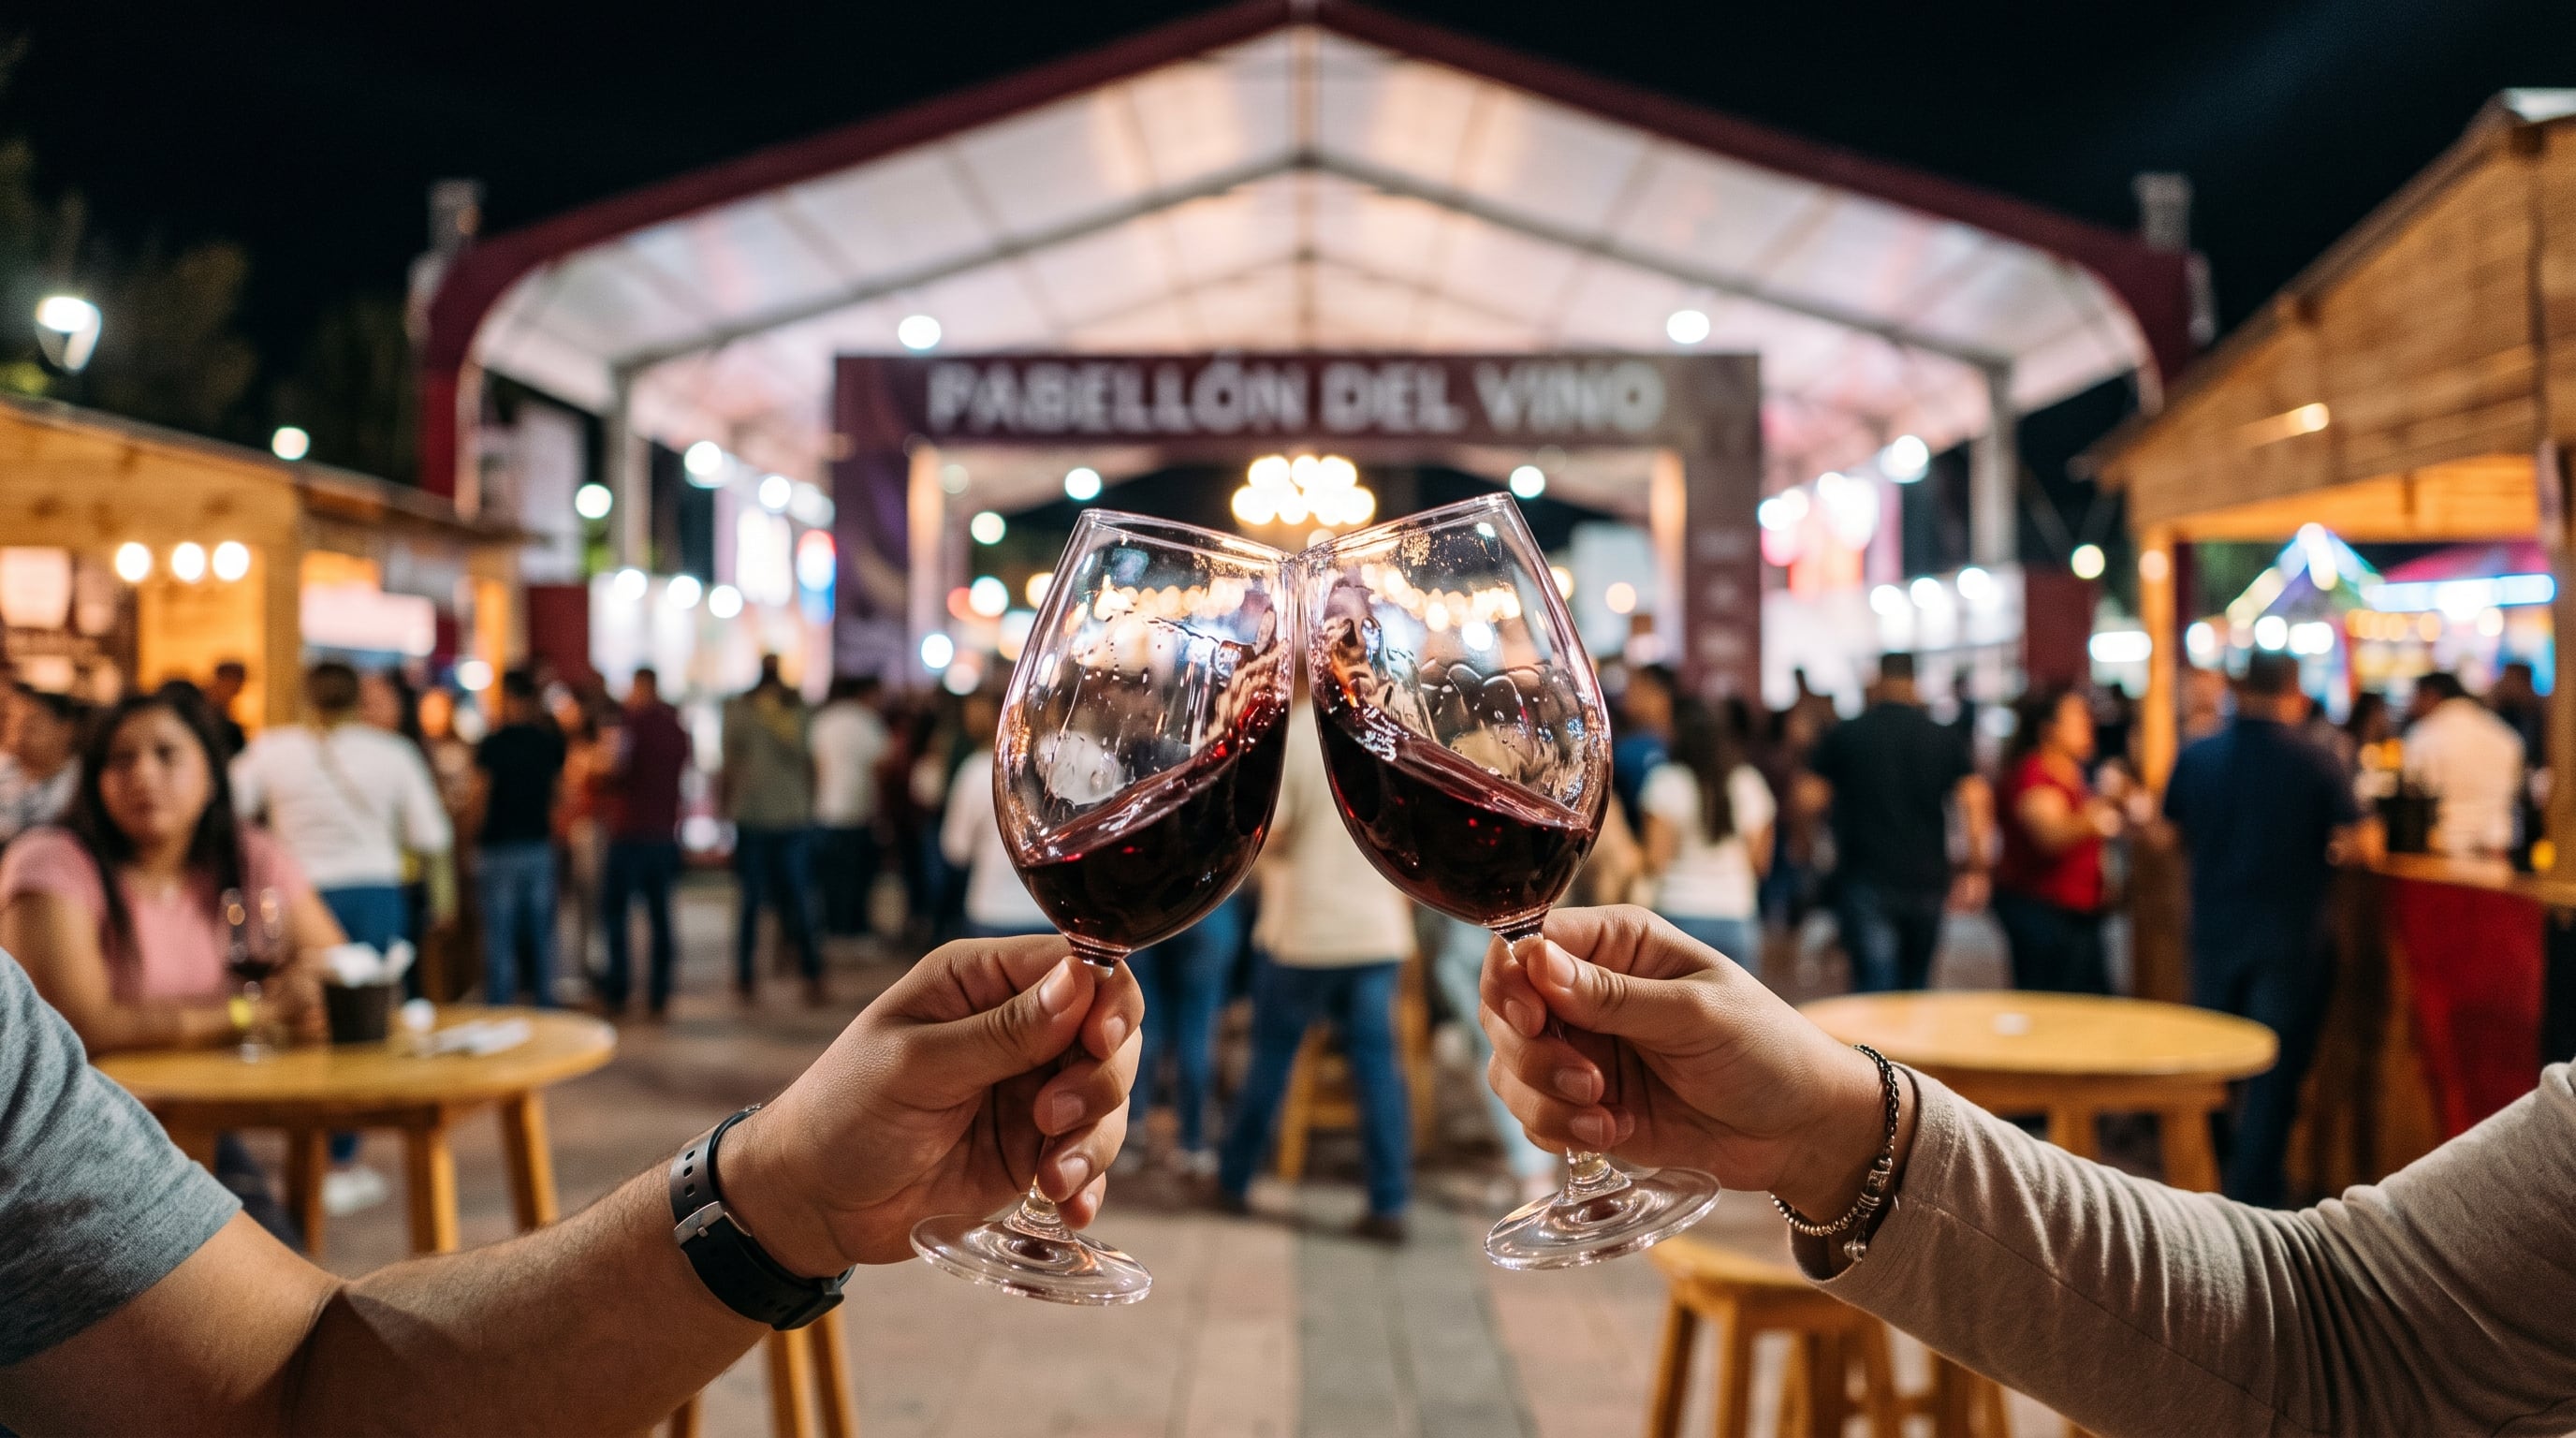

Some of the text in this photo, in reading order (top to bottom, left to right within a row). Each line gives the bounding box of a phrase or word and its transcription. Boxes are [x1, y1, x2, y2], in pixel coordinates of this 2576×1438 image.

[927, 350, 1664, 435] PABELLÓN DEL VINO
